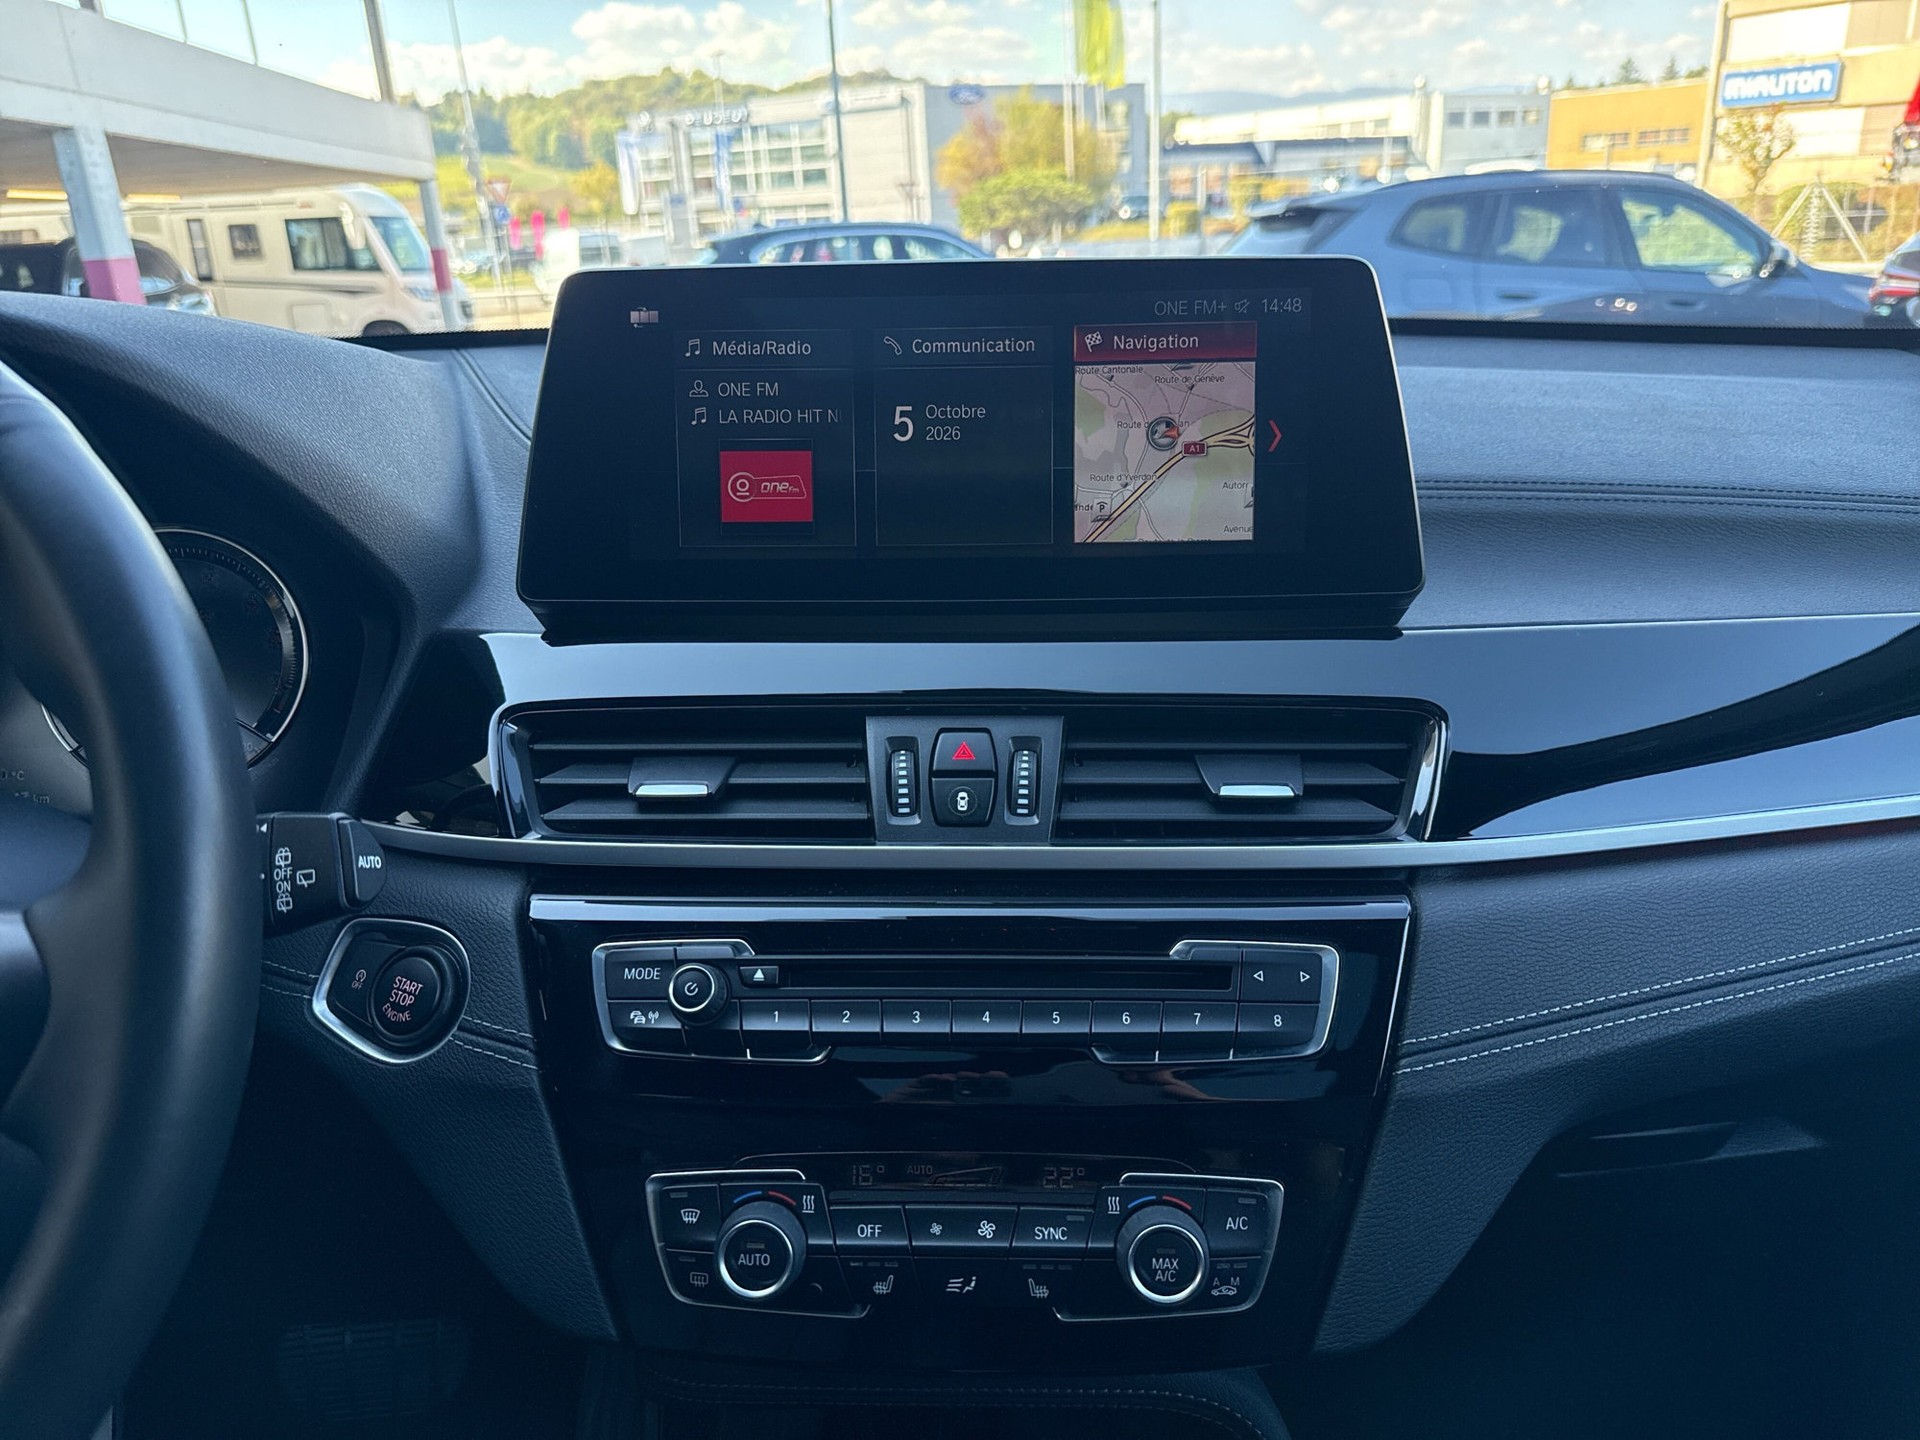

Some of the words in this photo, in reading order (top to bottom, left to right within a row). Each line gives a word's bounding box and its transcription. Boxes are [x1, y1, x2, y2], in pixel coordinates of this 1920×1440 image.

[1154, 300, 1188, 316] ONE
[1194, 299, 1227, 315] FM+
[1261, 297, 1303, 313] 14:48
[712, 339, 812, 356] Média/Radio
[912, 337, 1036, 354] Communication
[1113, 334, 1199, 352] Navigation
[1075, 366, 1100, 375] Route
[1102, 365, 1144, 375] Cantonale
[1154, 375, 1179, 384] Route
[1181, 375, 1192, 384] de
[1194, 373, 1225, 383] Genève
[718, 382, 752, 397] ONE
[756, 381, 780, 397] FM
[719, 409, 739, 424] LA
[743, 409, 792, 424] RADIO
[797, 409, 823, 423] HIT
[925, 403, 986, 419] Octobre
[893, 405, 914, 442] 5
[1117, 420, 1142, 429] Route
[925, 425, 961, 441] 2026
[1189, 445, 1200, 453] A1
[1090, 473, 1115, 482] Route
[1116, 472, 1157, 481] d'Yverdon
[761, 482, 789, 493] one
[358, 855, 382, 869] AUTO
[273, 866, 293, 881] OFF
[275, 880, 292, 893] ON
[623, 967, 661, 981] MODE
[351, 980, 363, 990] OFF
[393, 975, 424, 996] START
[389, 989, 415, 1007] STOP
[382, 1002, 412, 1022] ENGINE
[773, 1010, 780, 1023] 1
[841, 1010, 851, 1024] 2
[911, 1011, 921, 1024] 3
[982, 1011, 991, 1024] 4
[1051, 1011, 1061, 1025] 5
[1121, 1012, 1131, 1026] 6
[1193, 1012, 1202, 1026] 7
[1273, 1014, 1283, 1027] 8
[907, 1164, 934, 1175] AUTO
[857, 1223, 882, 1238] OFF
[1225, 1216, 1248, 1231] A/C
[1034, 1226, 1068, 1241] SYNC
[738, 1253, 771, 1267] AUTO
[1152, 1257, 1179, 1270] MAX
[1155, 1269, 1177, 1283] A/C
[1212, 1276, 1220, 1286] A
[1230, 1276, 1240, 1286] M
